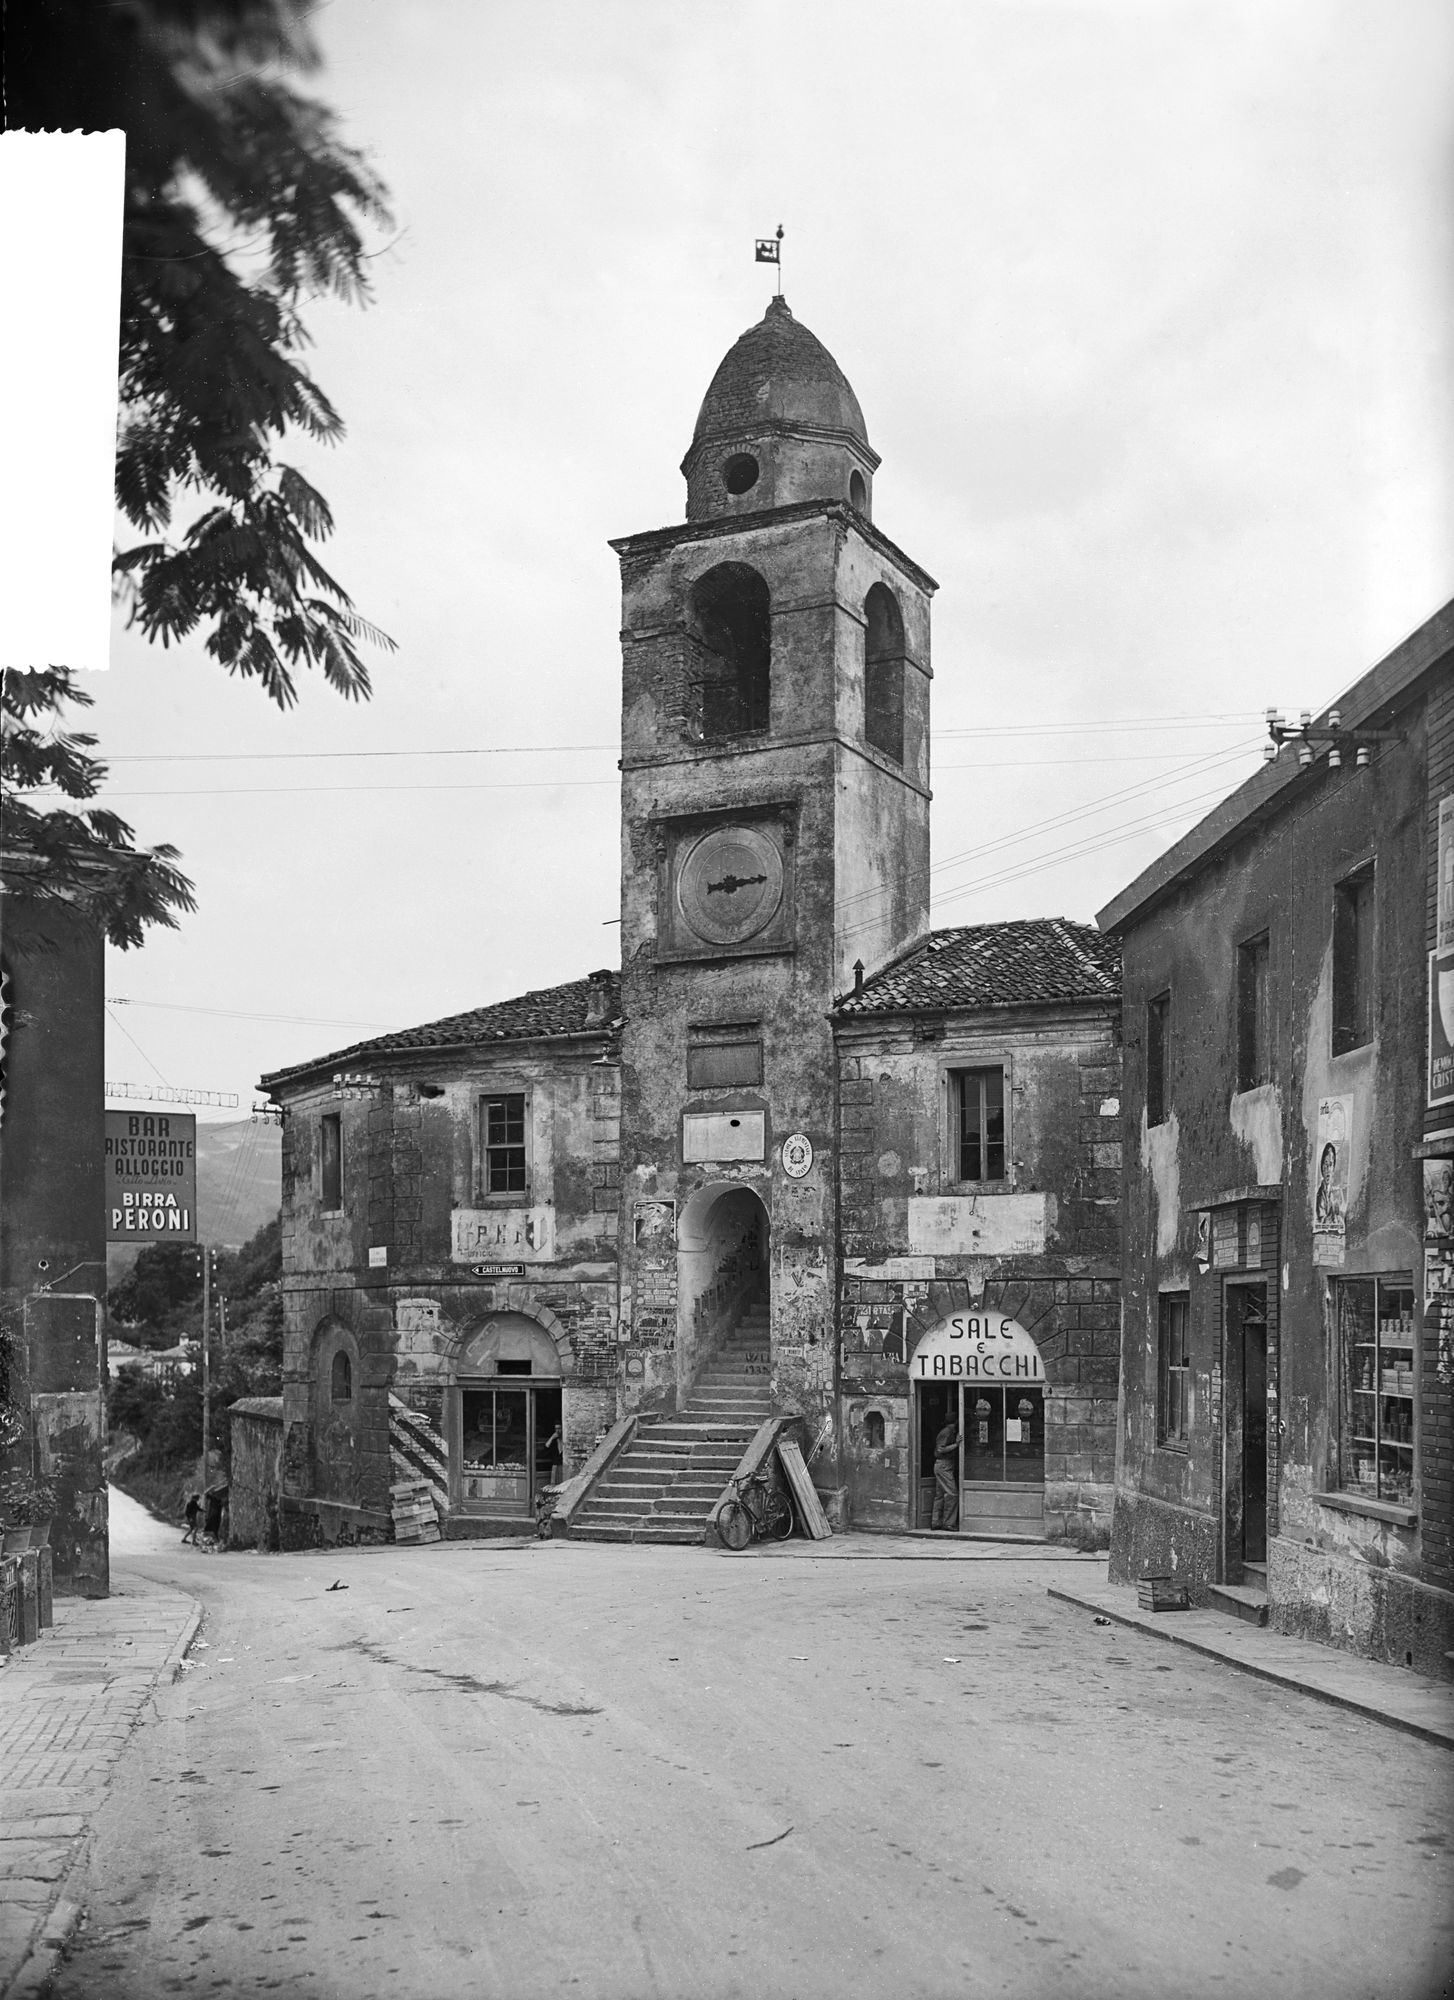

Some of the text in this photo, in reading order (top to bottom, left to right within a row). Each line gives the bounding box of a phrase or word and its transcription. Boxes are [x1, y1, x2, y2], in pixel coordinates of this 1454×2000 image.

[129, 1116, 170, 1137] BAR
[105, 1139, 193, 1158] RISTORANTE
[115, 1159, 184, 1176] ALLOGGIO
[123, 1192, 177, 1207] BIRRA
[112, 1208, 189, 1231] PERONI
[482, 1265, 519, 1274] CASTELNUOVO
[949, 1317, 1014, 1340] SALE
[976, 1341, 986, 1354] E
[917, 1354, 1038, 1377] TABACCHI
